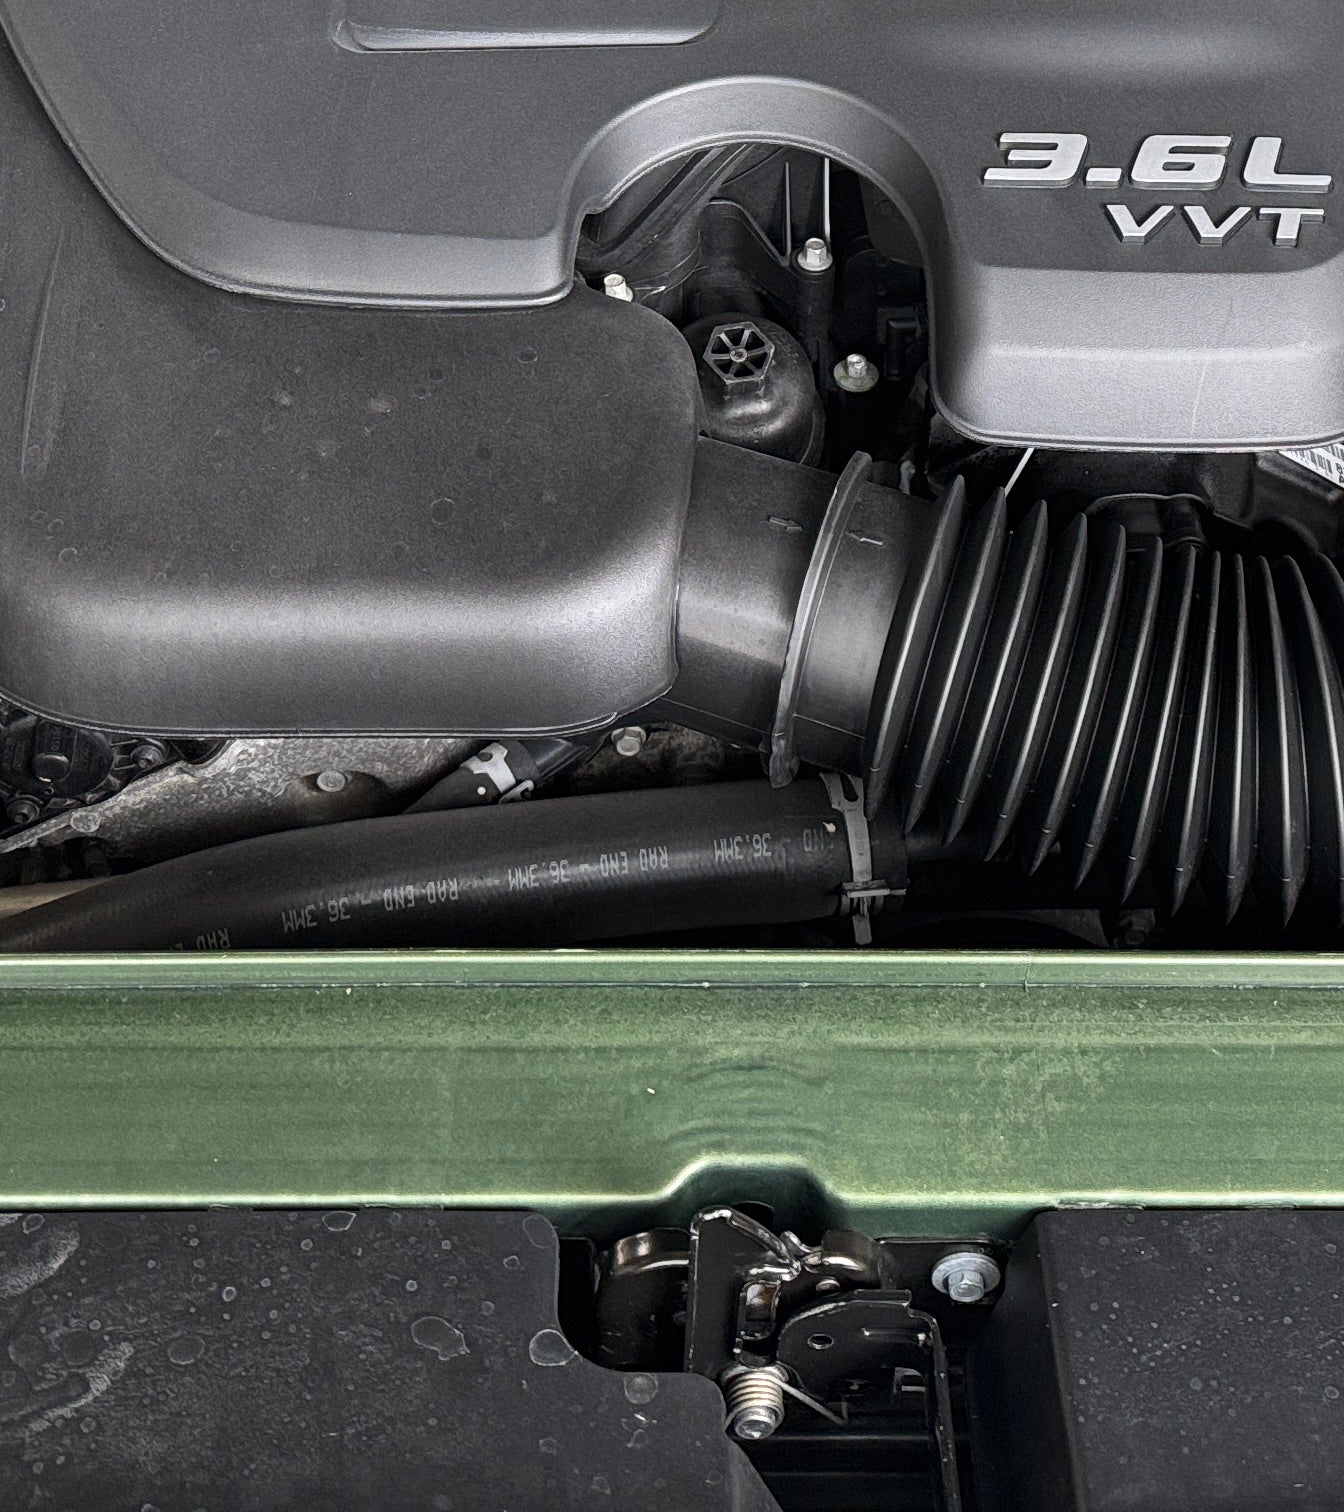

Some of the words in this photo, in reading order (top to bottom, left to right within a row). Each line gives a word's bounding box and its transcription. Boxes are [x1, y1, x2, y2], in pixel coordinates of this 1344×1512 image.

[982, 132, 1334, 193] 3.6L
[1105, 204, 1326, 247] VVT
[639, 845, 669, 871] RAD
[713, 832, 773, 863] 36.3MM
[507, 859, 570, 893] 36.3MM
[599, 851, 629, 877] END
[427, 877, 459, 905] RAD
[281, 897, 352, 934] 36.3MM
